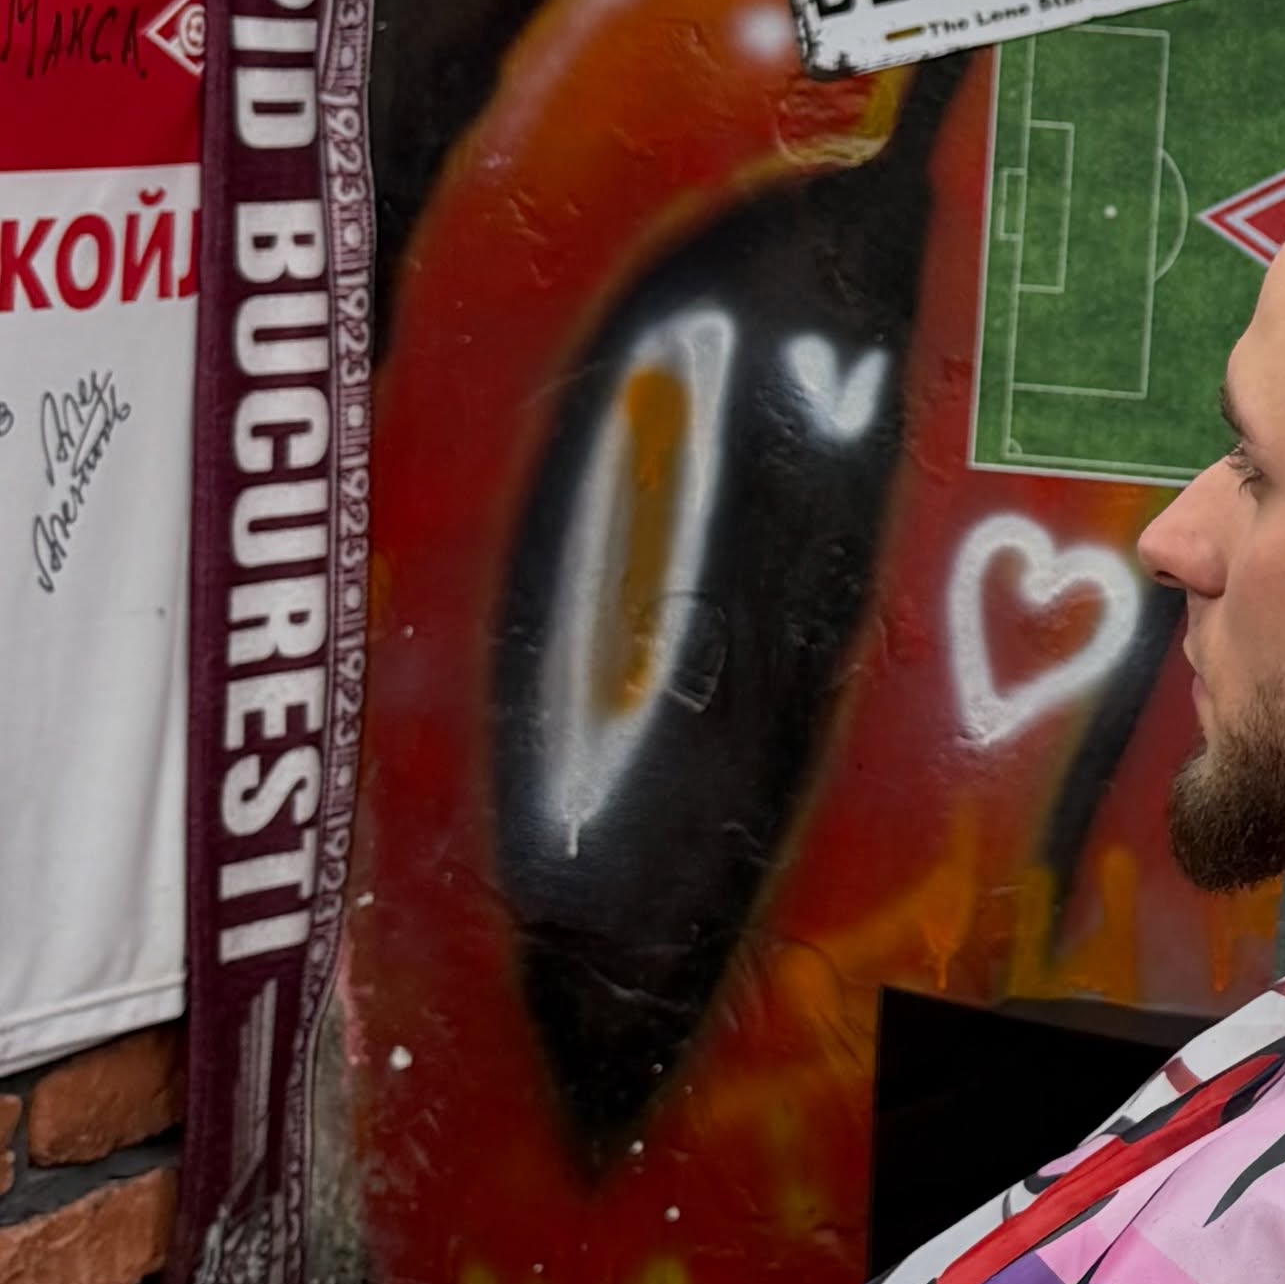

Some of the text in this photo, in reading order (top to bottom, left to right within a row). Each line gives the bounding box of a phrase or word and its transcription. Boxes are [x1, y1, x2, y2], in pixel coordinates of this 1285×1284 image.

[928, 17, 969, 36] The
[977, 3, 1031, 26] Lone
[321, 90, 366, 203] 1923
[336, 269, 371, 387] 1923
[339, 451, 371, 567] 1923
[219, 199, 330, 964] BUCURESTI
[334, 629, 365, 747] 1923
